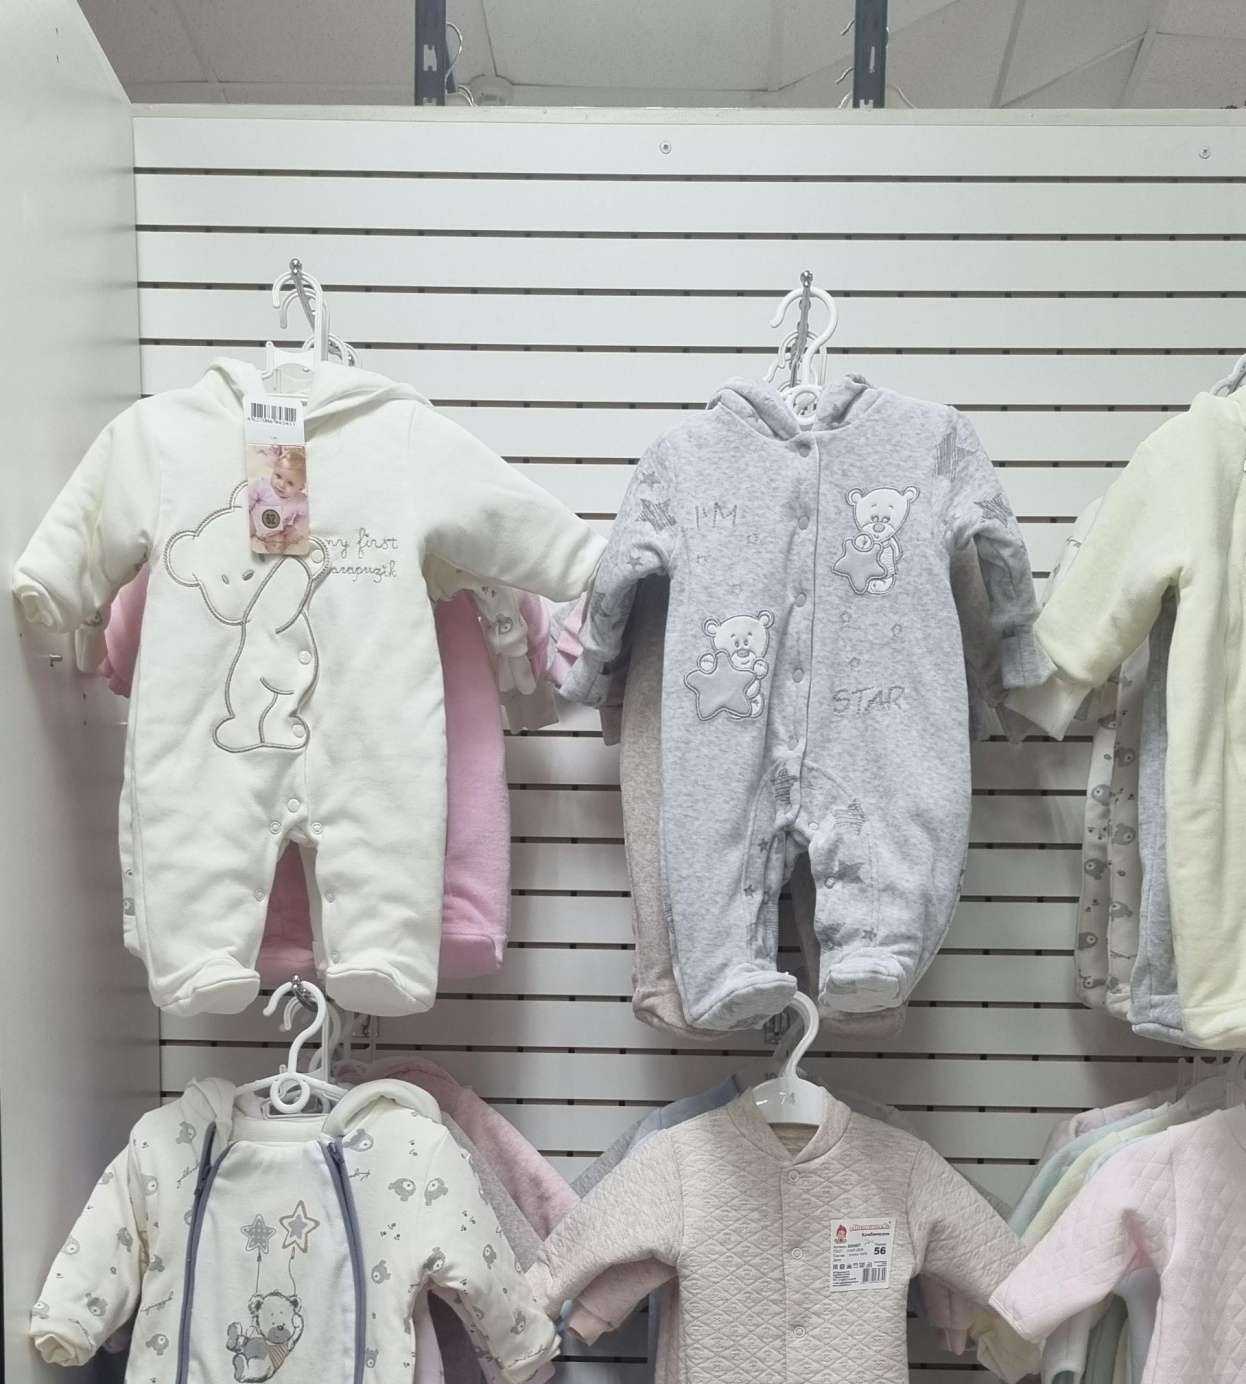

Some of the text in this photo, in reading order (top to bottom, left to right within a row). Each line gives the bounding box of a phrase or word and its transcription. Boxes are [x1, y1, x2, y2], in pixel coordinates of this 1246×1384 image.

[358, 527, 398, 559] first
[330, 560, 397, 583] arapuzik
[874, 1246, 887, 1255] 56
